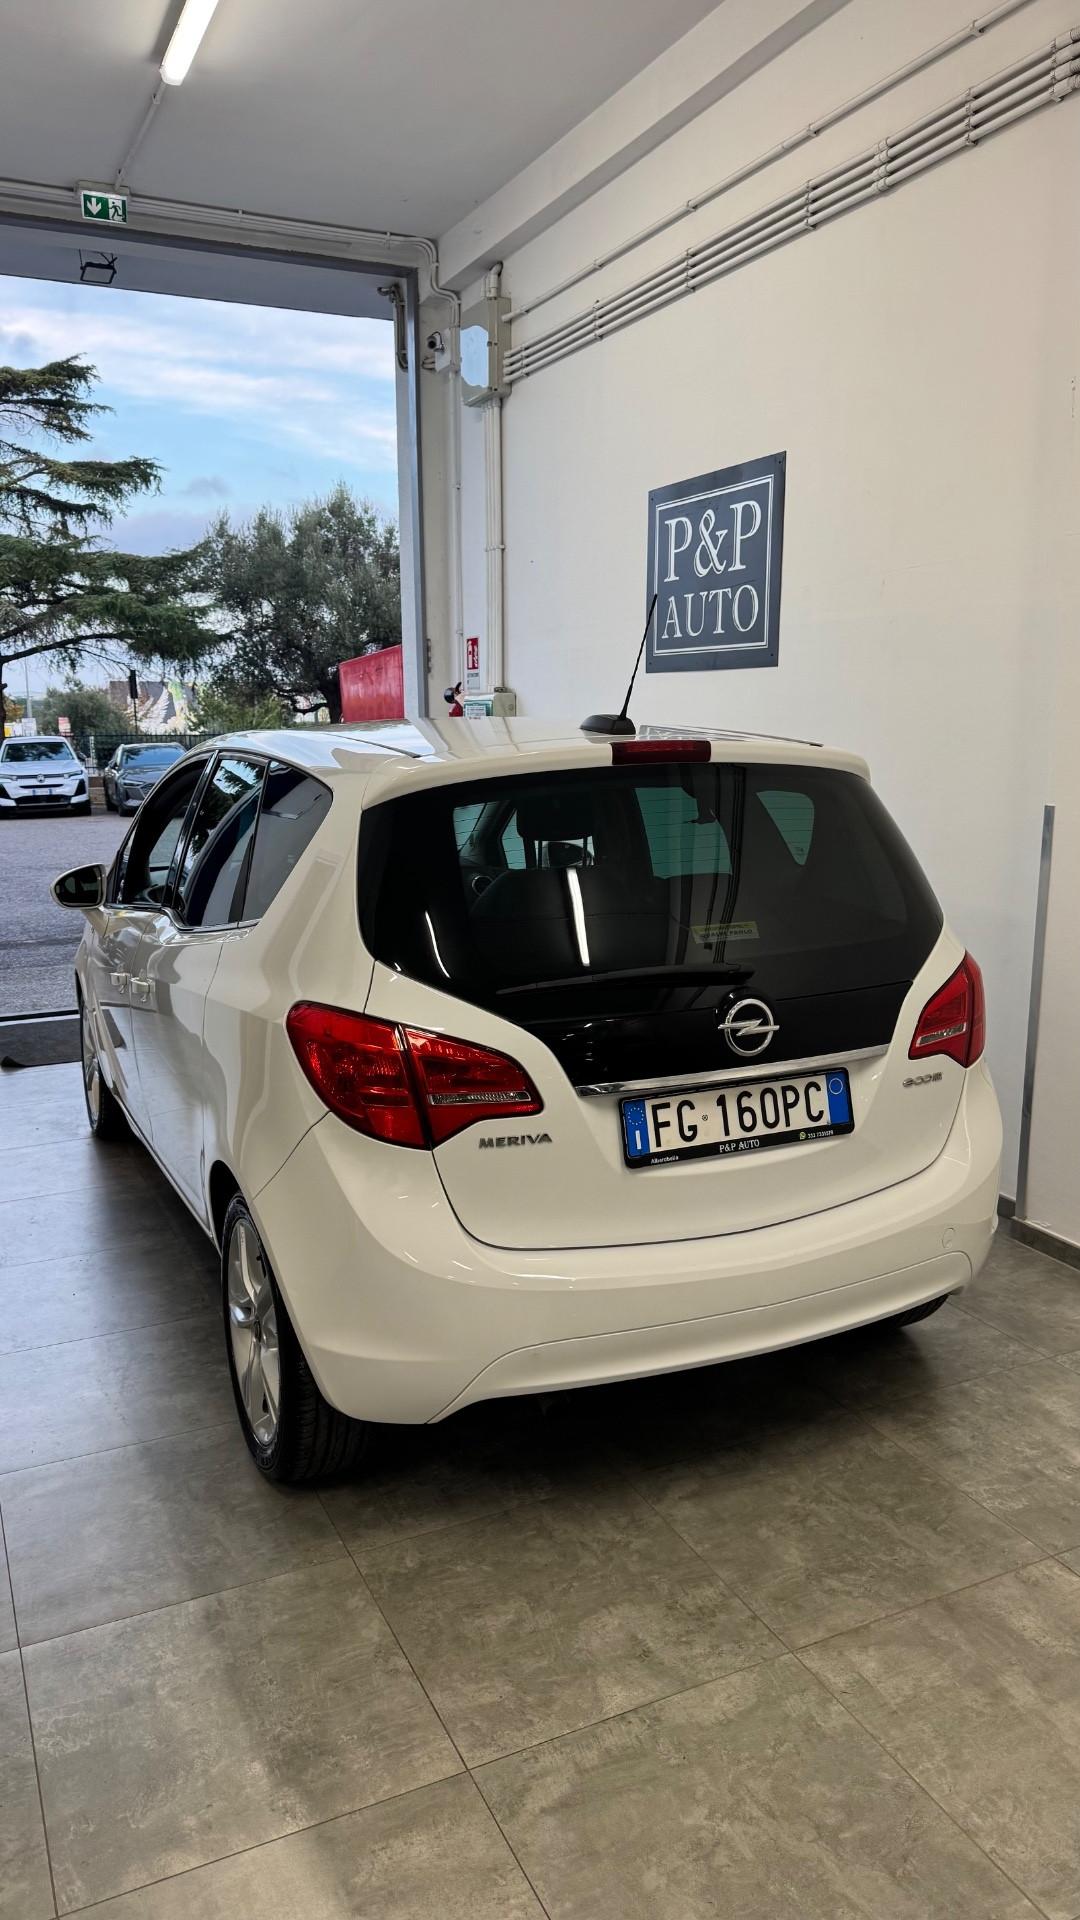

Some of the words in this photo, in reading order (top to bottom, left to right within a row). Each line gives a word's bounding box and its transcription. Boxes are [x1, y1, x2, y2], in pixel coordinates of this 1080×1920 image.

[663, 499, 762, 583] P&P
[661, 584, 759, 639] AUTO
[478, 1133, 553, 1149] MERIVA
[651, 1099, 698, 1148] FG
[716, 1081, 825, 1137] 160PC
[719, 1142, 736, 1153] P&P
[738, 1139, 760, 1150] AUTO
